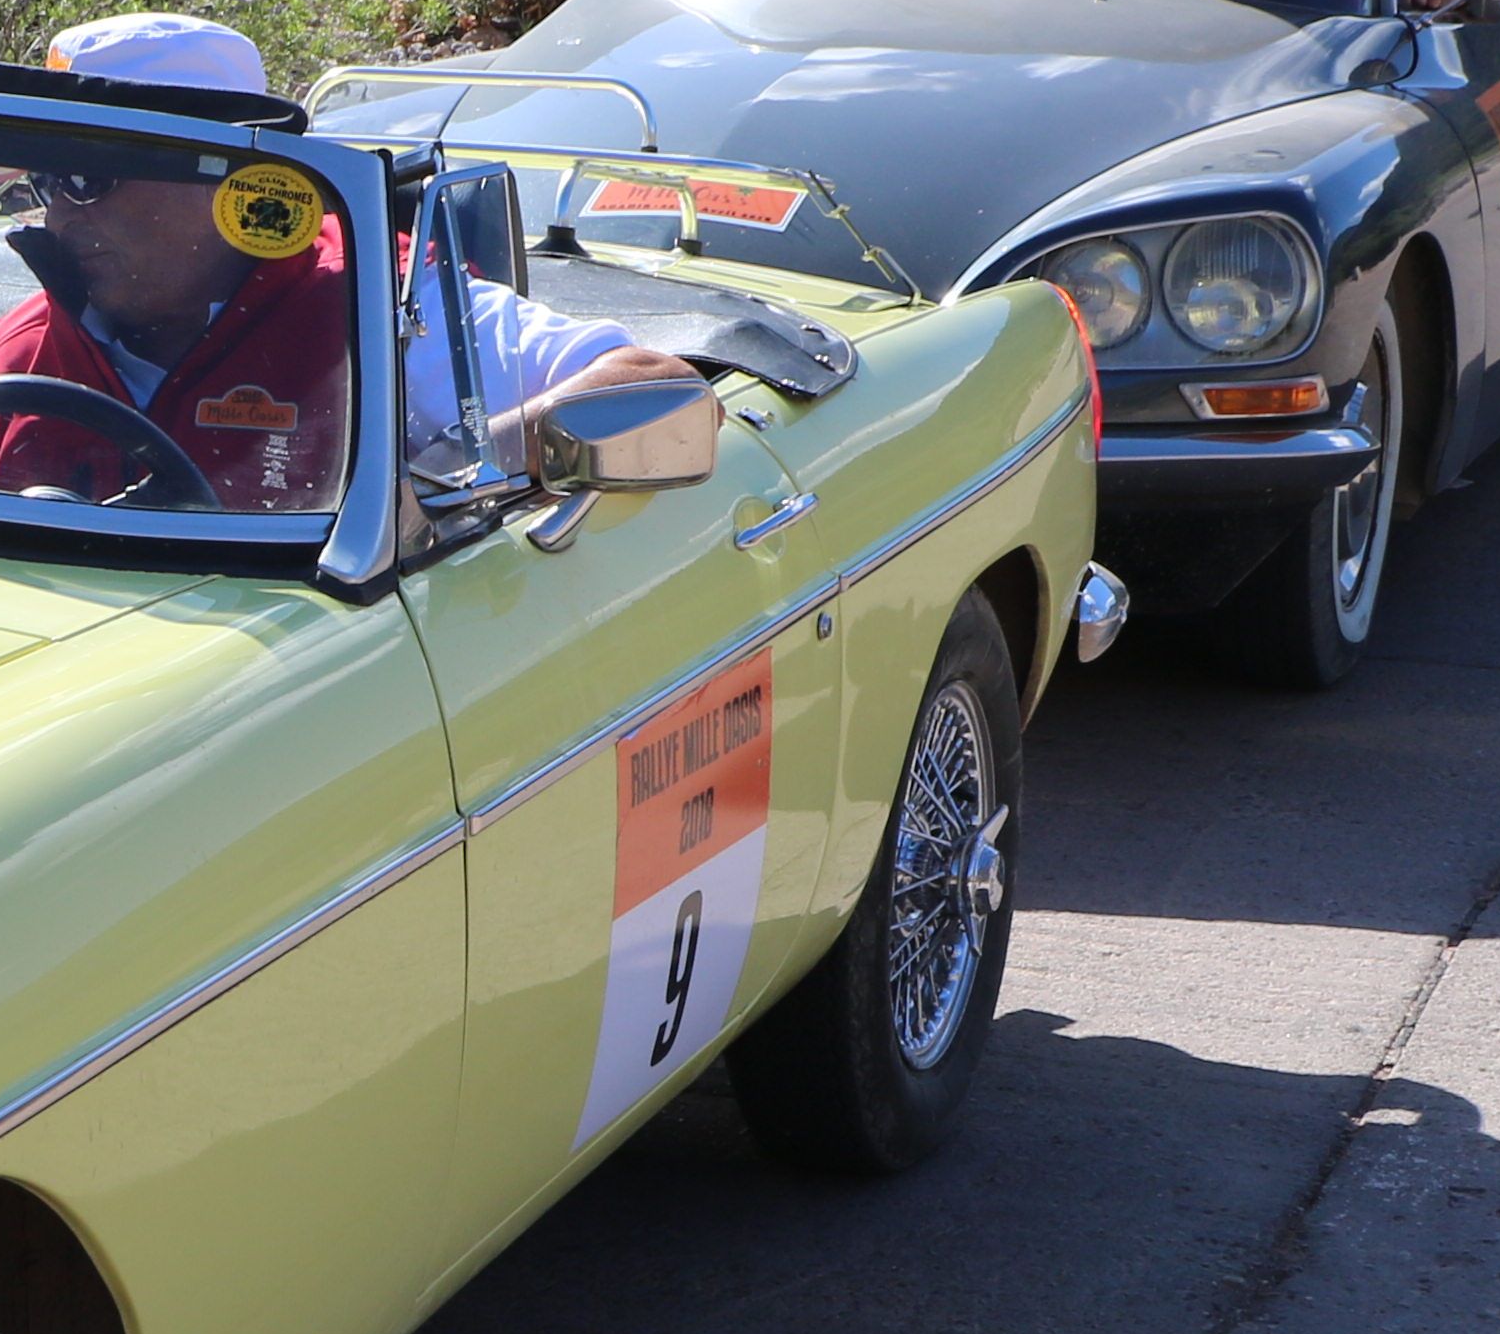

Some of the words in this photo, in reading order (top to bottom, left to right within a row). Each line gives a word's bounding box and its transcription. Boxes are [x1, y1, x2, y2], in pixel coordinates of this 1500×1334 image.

[228, 178, 267, 195] FRENCH
[267, 186, 314, 206] CHROMES
[258, 177, 288, 188] CLUB
[630, 730, 679, 808] RALLYE
[683, 707, 720, 779] MILLE
[722, 683, 763, 756] OASIS
[678, 785, 715, 855] 2018
[650, 889, 703, 1067] 9
